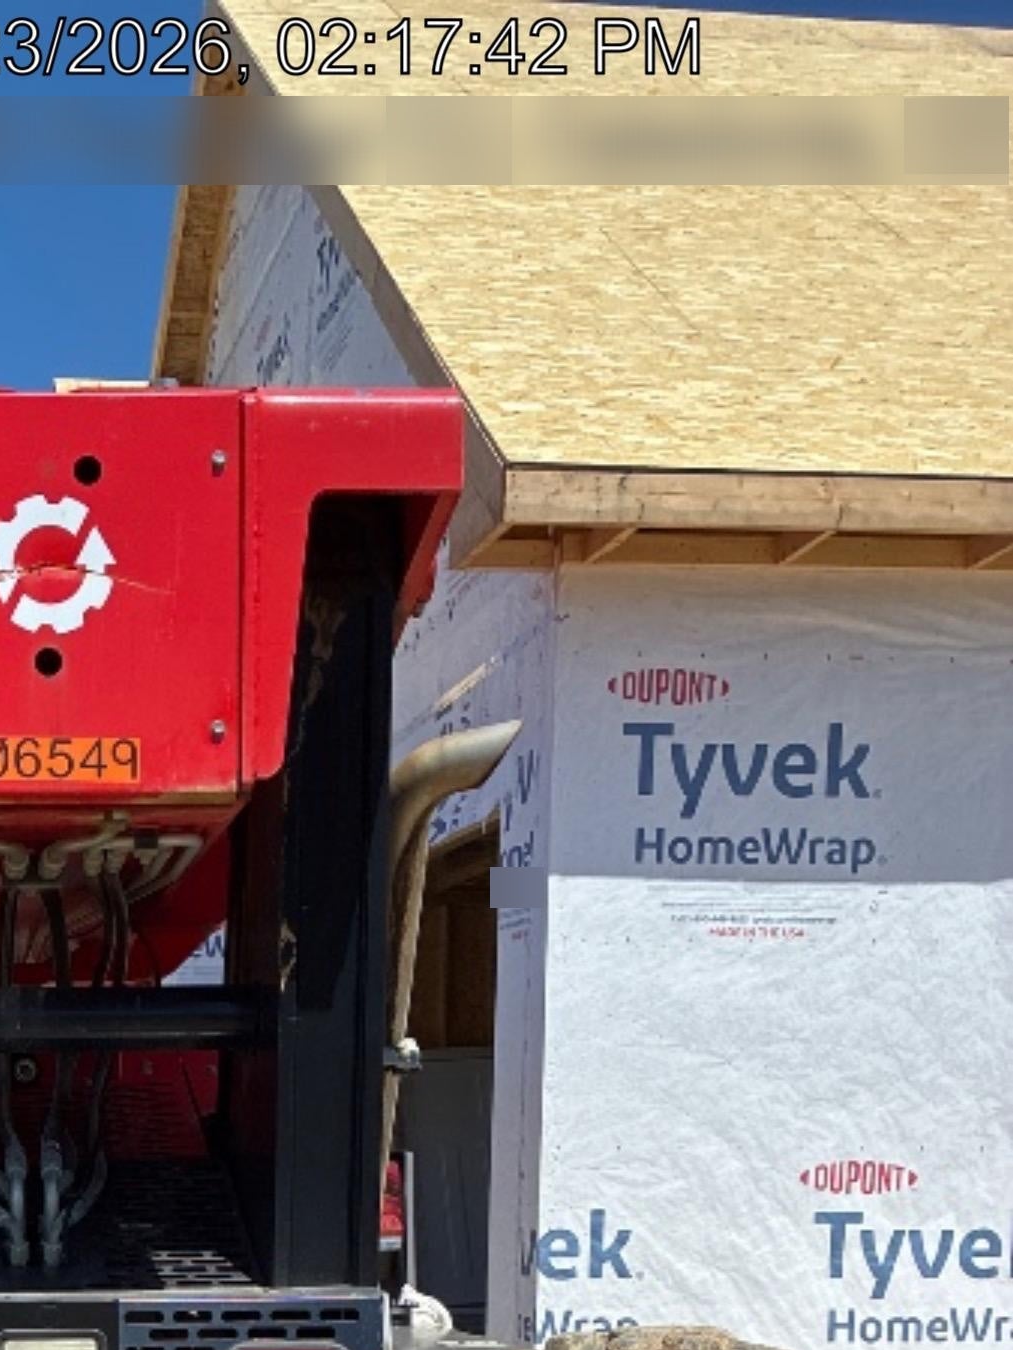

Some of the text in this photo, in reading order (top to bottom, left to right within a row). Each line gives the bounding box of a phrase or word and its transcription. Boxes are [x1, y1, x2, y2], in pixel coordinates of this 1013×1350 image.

[622, 668, 717, 705] DUPONT
[622, 722, 871, 819] Tyvek
[635, 827, 876, 874] HomeWrap
[814, 1160, 905, 1195] DUPONT
[814, 1211, 1013, 1300] Tyve
[827, 1307, 1013, 1344] HomeWr
